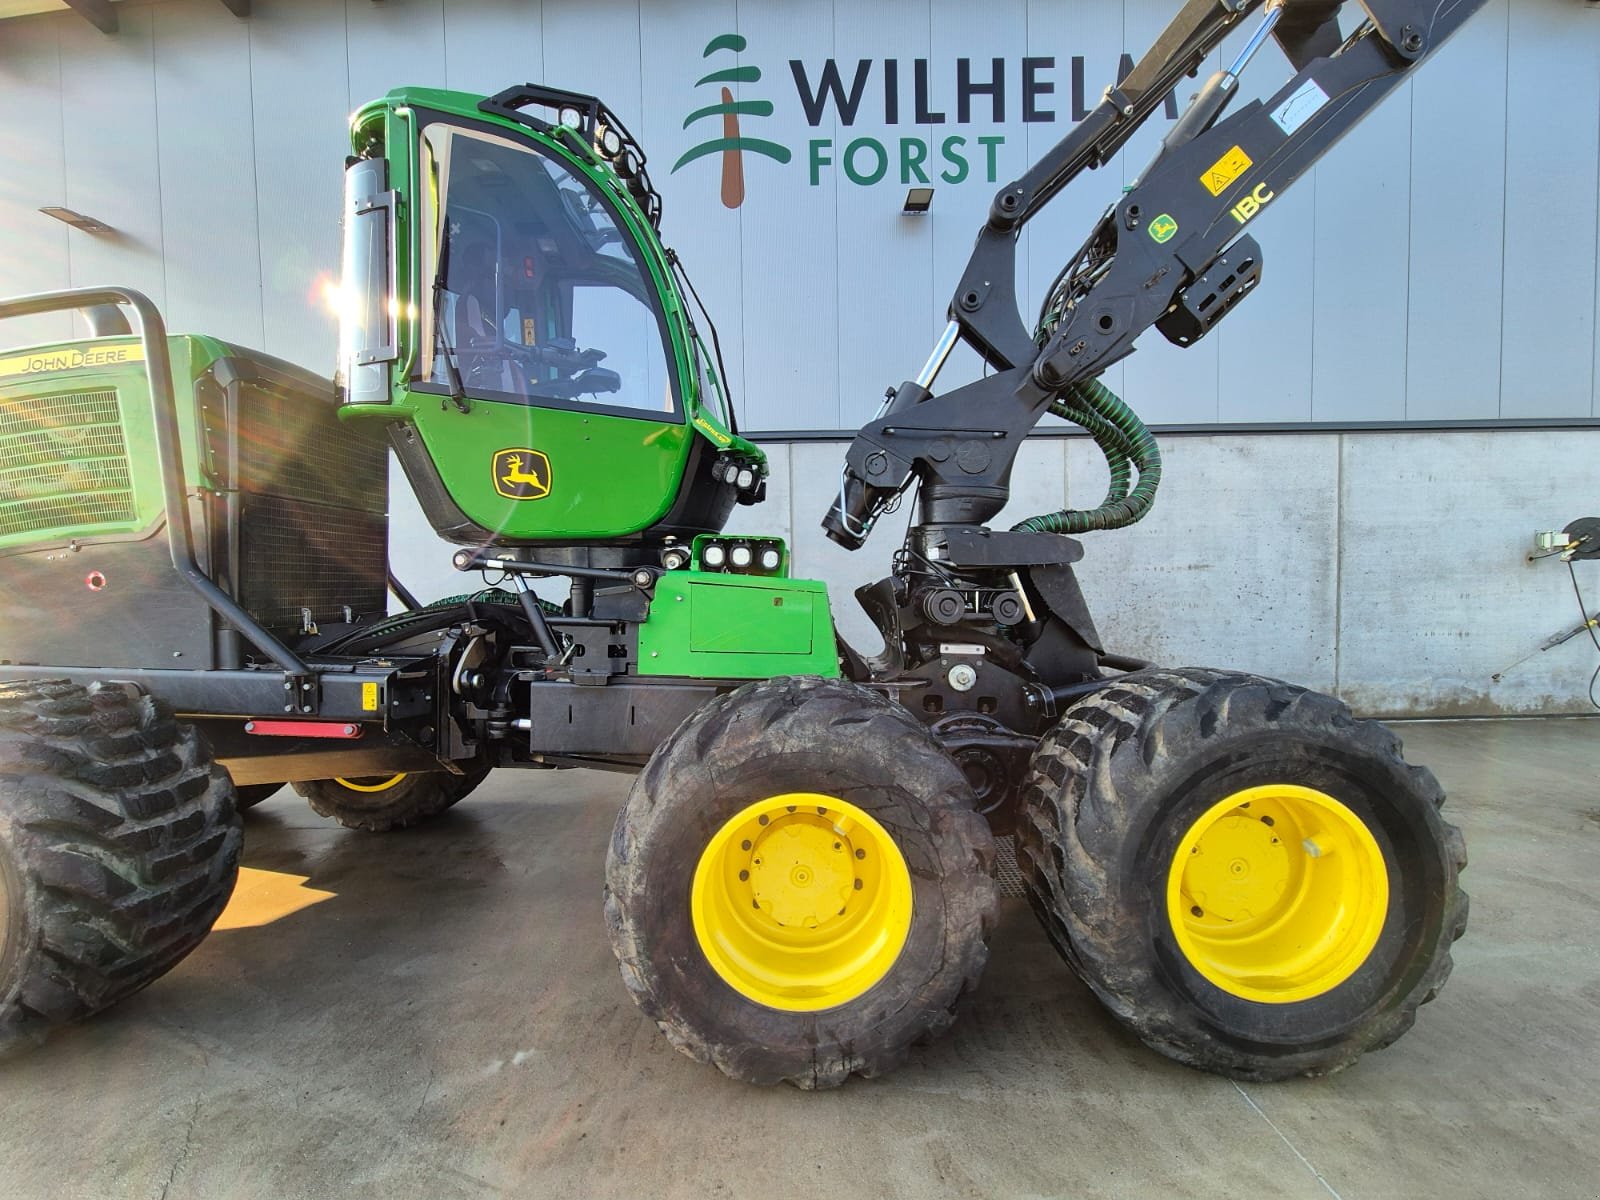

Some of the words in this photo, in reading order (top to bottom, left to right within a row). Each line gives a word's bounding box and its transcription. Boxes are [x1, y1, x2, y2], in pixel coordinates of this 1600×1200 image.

[809, 136, 1005, 186] FORST
[1230, 181, 1274, 224] IBC
[21, 356, 67, 372] JOHN
[72, 350, 128, 367] DEERE
